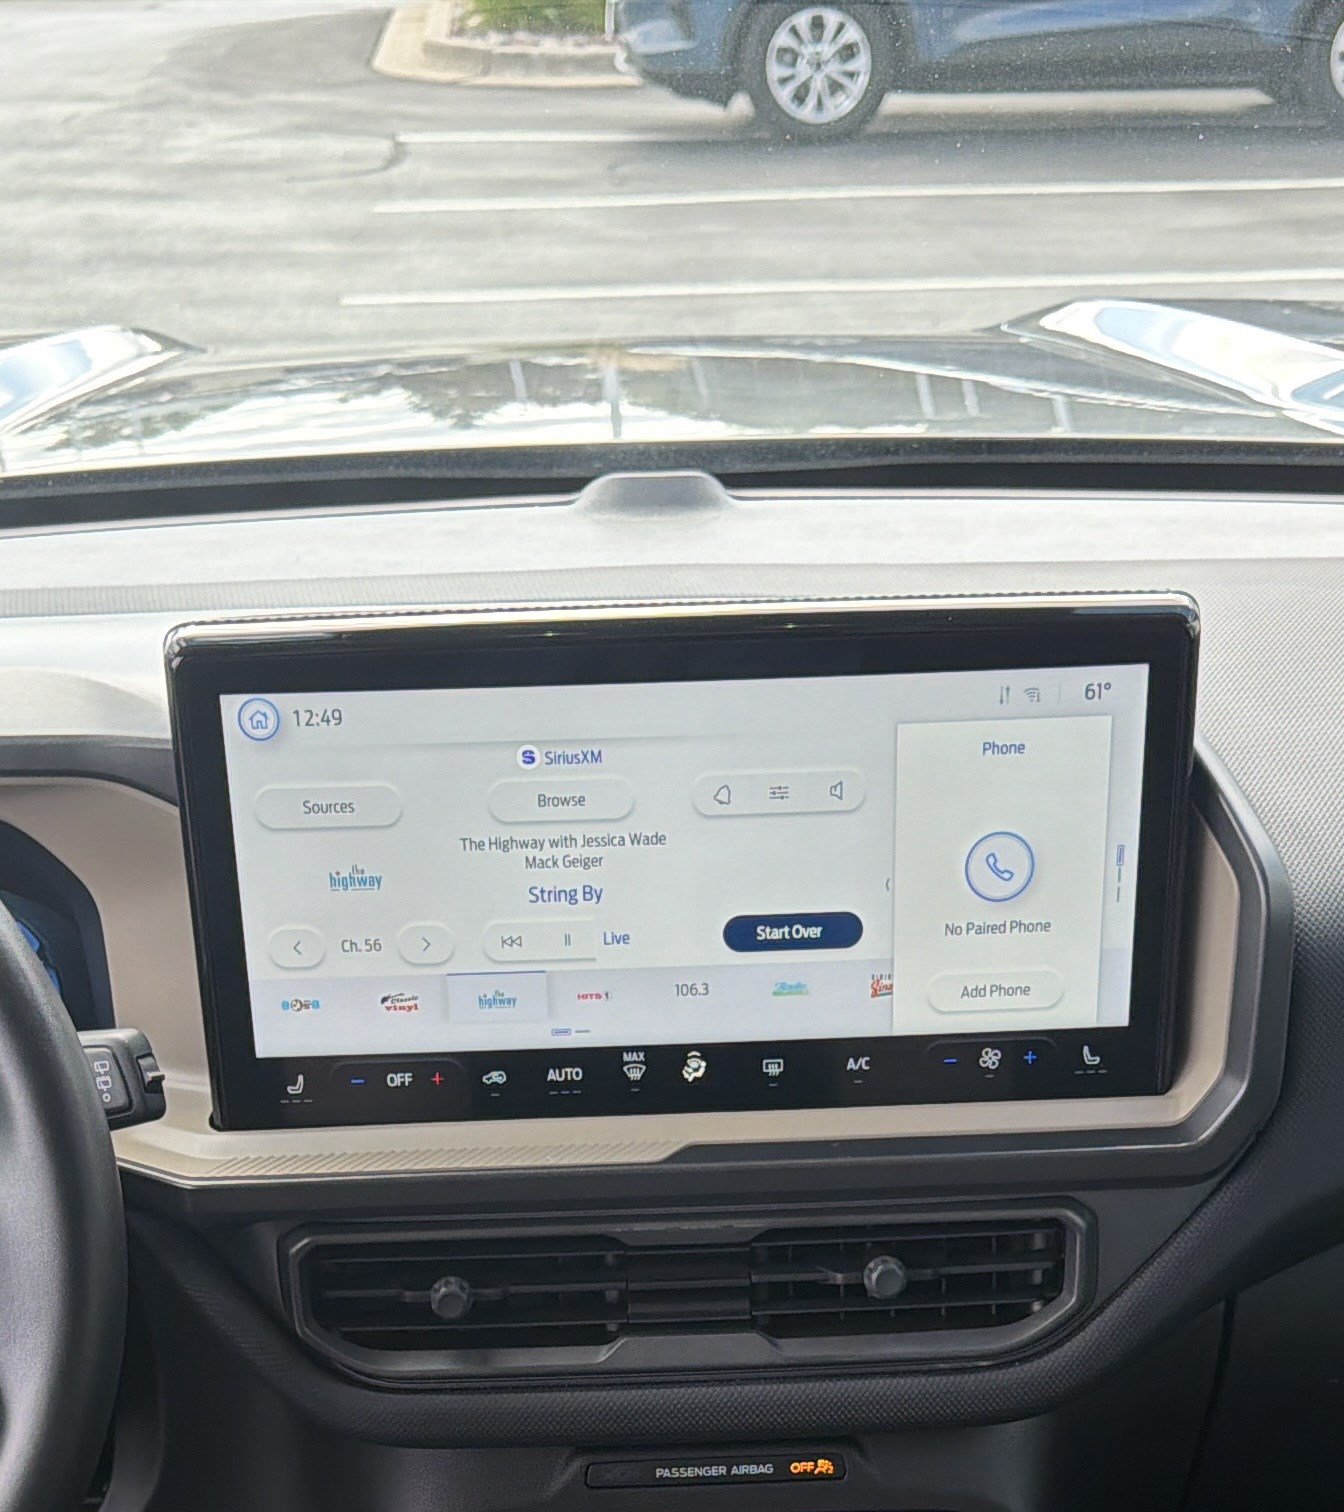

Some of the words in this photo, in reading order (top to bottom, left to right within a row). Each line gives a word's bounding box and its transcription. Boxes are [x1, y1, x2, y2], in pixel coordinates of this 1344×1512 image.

[1084, 682, 1112, 702] 61°
[292, 708, 343, 729] 12:49
[544, 748, 603, 766] SiriusXM
[982, 741, 1026, 758] Phone
[302, 799, 355, 815] Sources
[537, 792, 586, 808] Browse
[459, 836, 485, 852] The
[488, 836, 546, 854] Highway
[548, 834, 577, 850] with
[580, 832, 626, 849] Jessica
[629, 831, 667, 847] Wade
[524, 854, 559, 870] Mack
[562, 853, 604, 872] Geiger
[329, 871, 383, 892] highway
[528, 885, 578, 905] String
[581, 884, 603, 904] By
[756, 925, 789, 940] Start
[792, 924, 823, 939] Over
[944, 921, 962, 937] No
[965, 920, 1004, 936] Paired
[1007, 919, 1051, 934] Phone
[341, 938, 361, 953] Ch.
[364, 938, 382, 953] 56
[602, 931, 631, 946] Live
[675, 982, 709, 997] 106.3
[960, 983, 986, 998] Add
[989, 981, 1031, 998] Phone
[478, 994, 517, 1009] highway
[623, 1051, 645, 1062] MAX
[846, 1056, 871, 1071] A/C
[386, 1072, 413, 1087] OFF
[546, 1067, 583, 1082] AUTO
[656, 1465, 727, 1478] PASSENGER
[731, 1463, 774, 1475] AIRBAG
[789, 1462, 815, 1474] OFF
